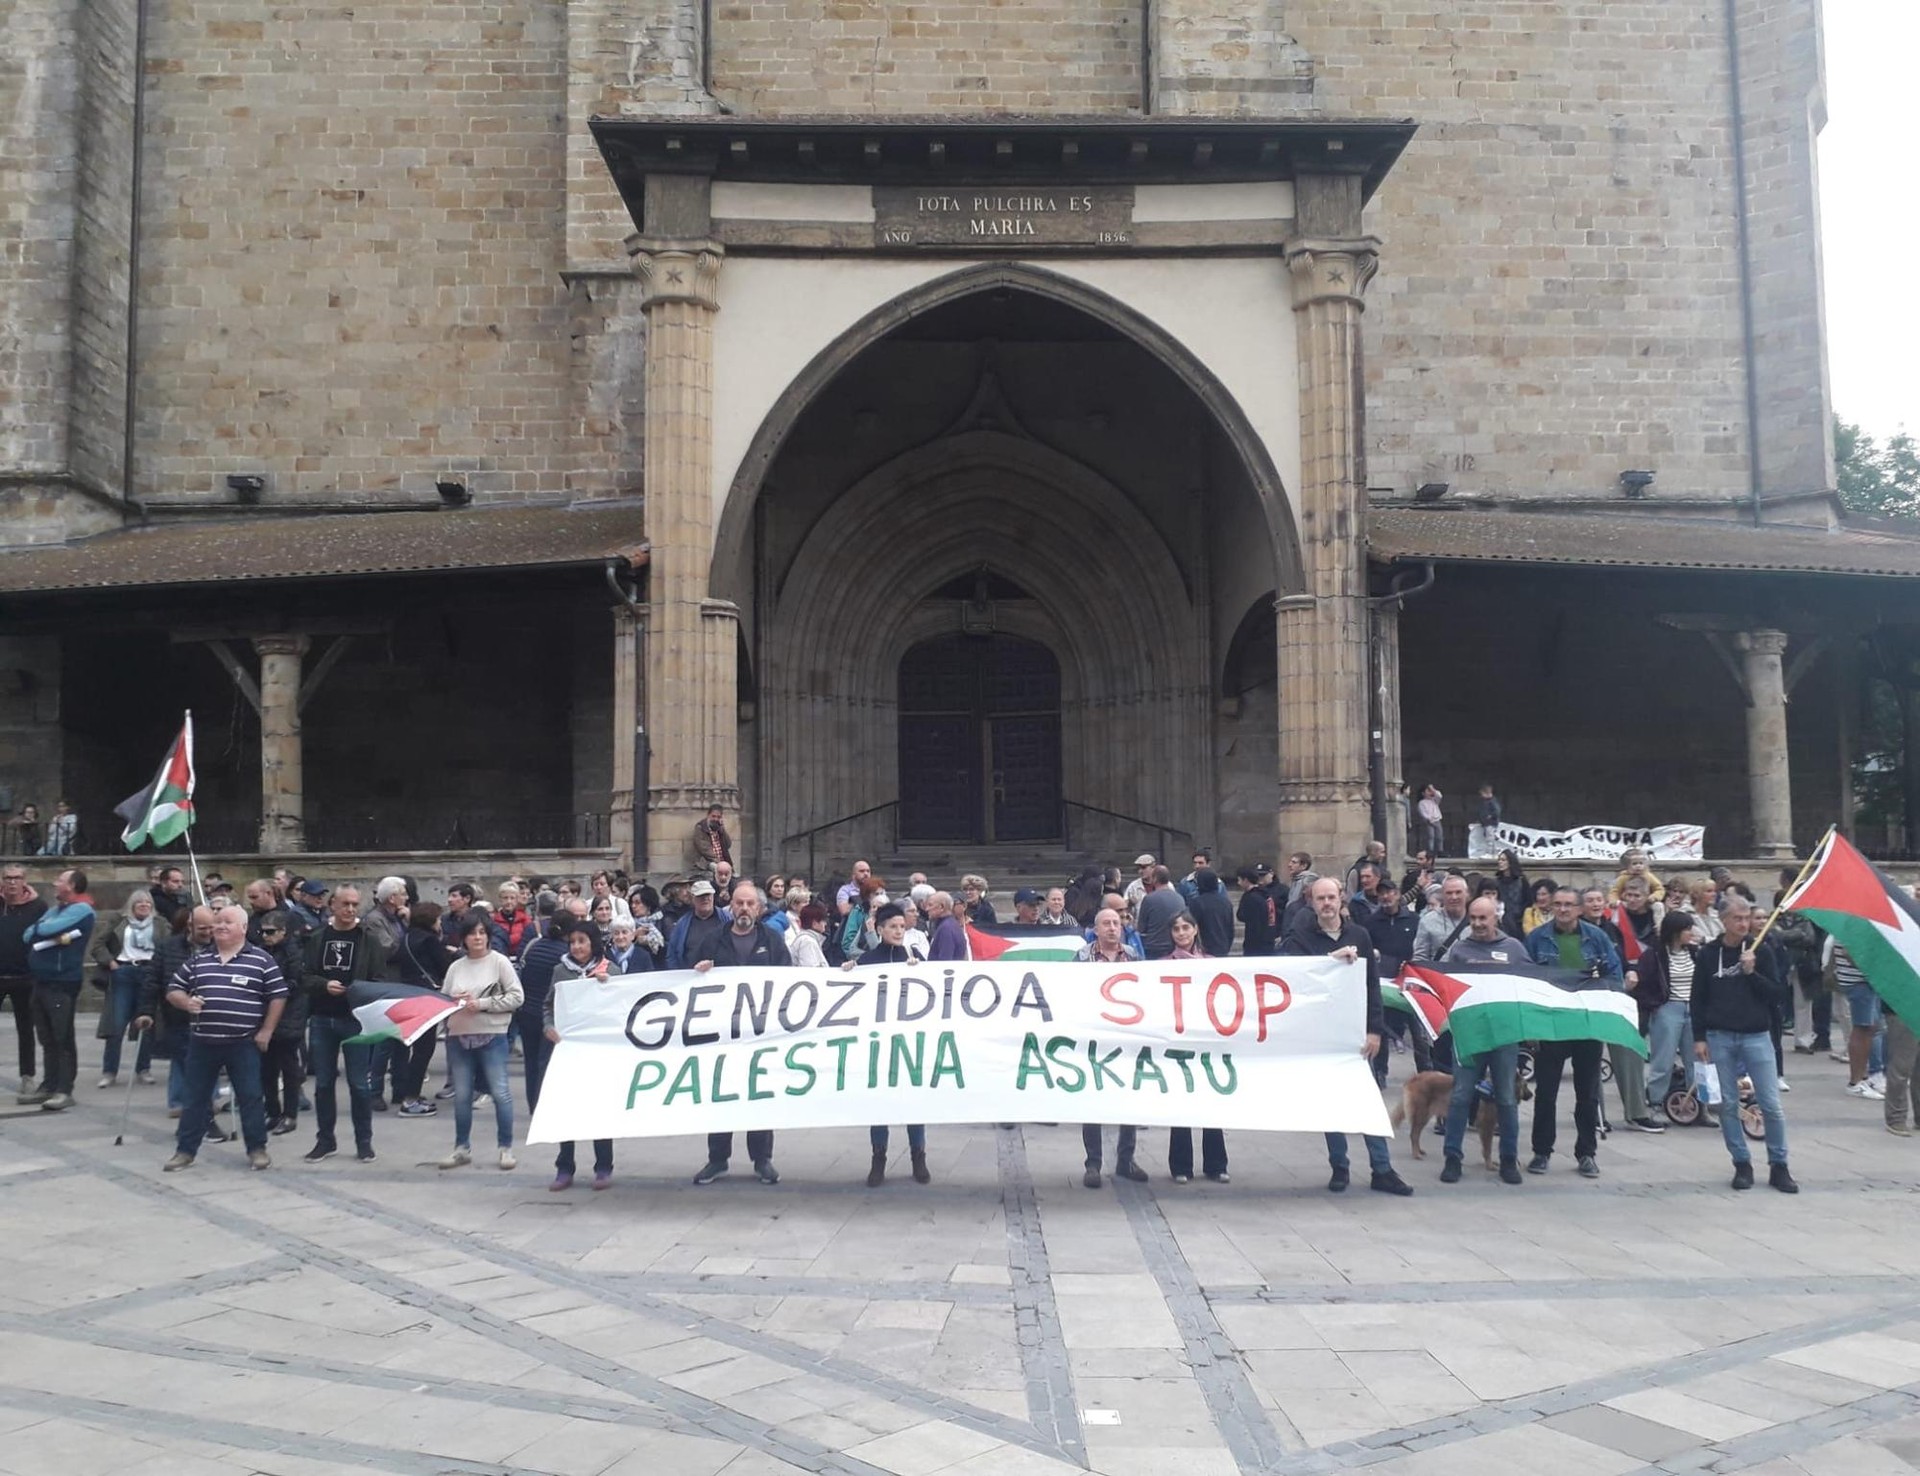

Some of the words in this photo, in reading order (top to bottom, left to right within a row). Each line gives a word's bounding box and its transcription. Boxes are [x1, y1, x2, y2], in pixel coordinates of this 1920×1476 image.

[916, 196, 961, 211] TOTA
[973, 196, 1057, 211] PULCHRA
[1069, 196, 1092, 212] ES
[970, 215, 1035, 235] MARÍA
[1578, 828, 1654, 846] EGUNA
[1099, 972, 1293, 1043] STOP
[1015, 1031, 1239, 1096] ASKATU
